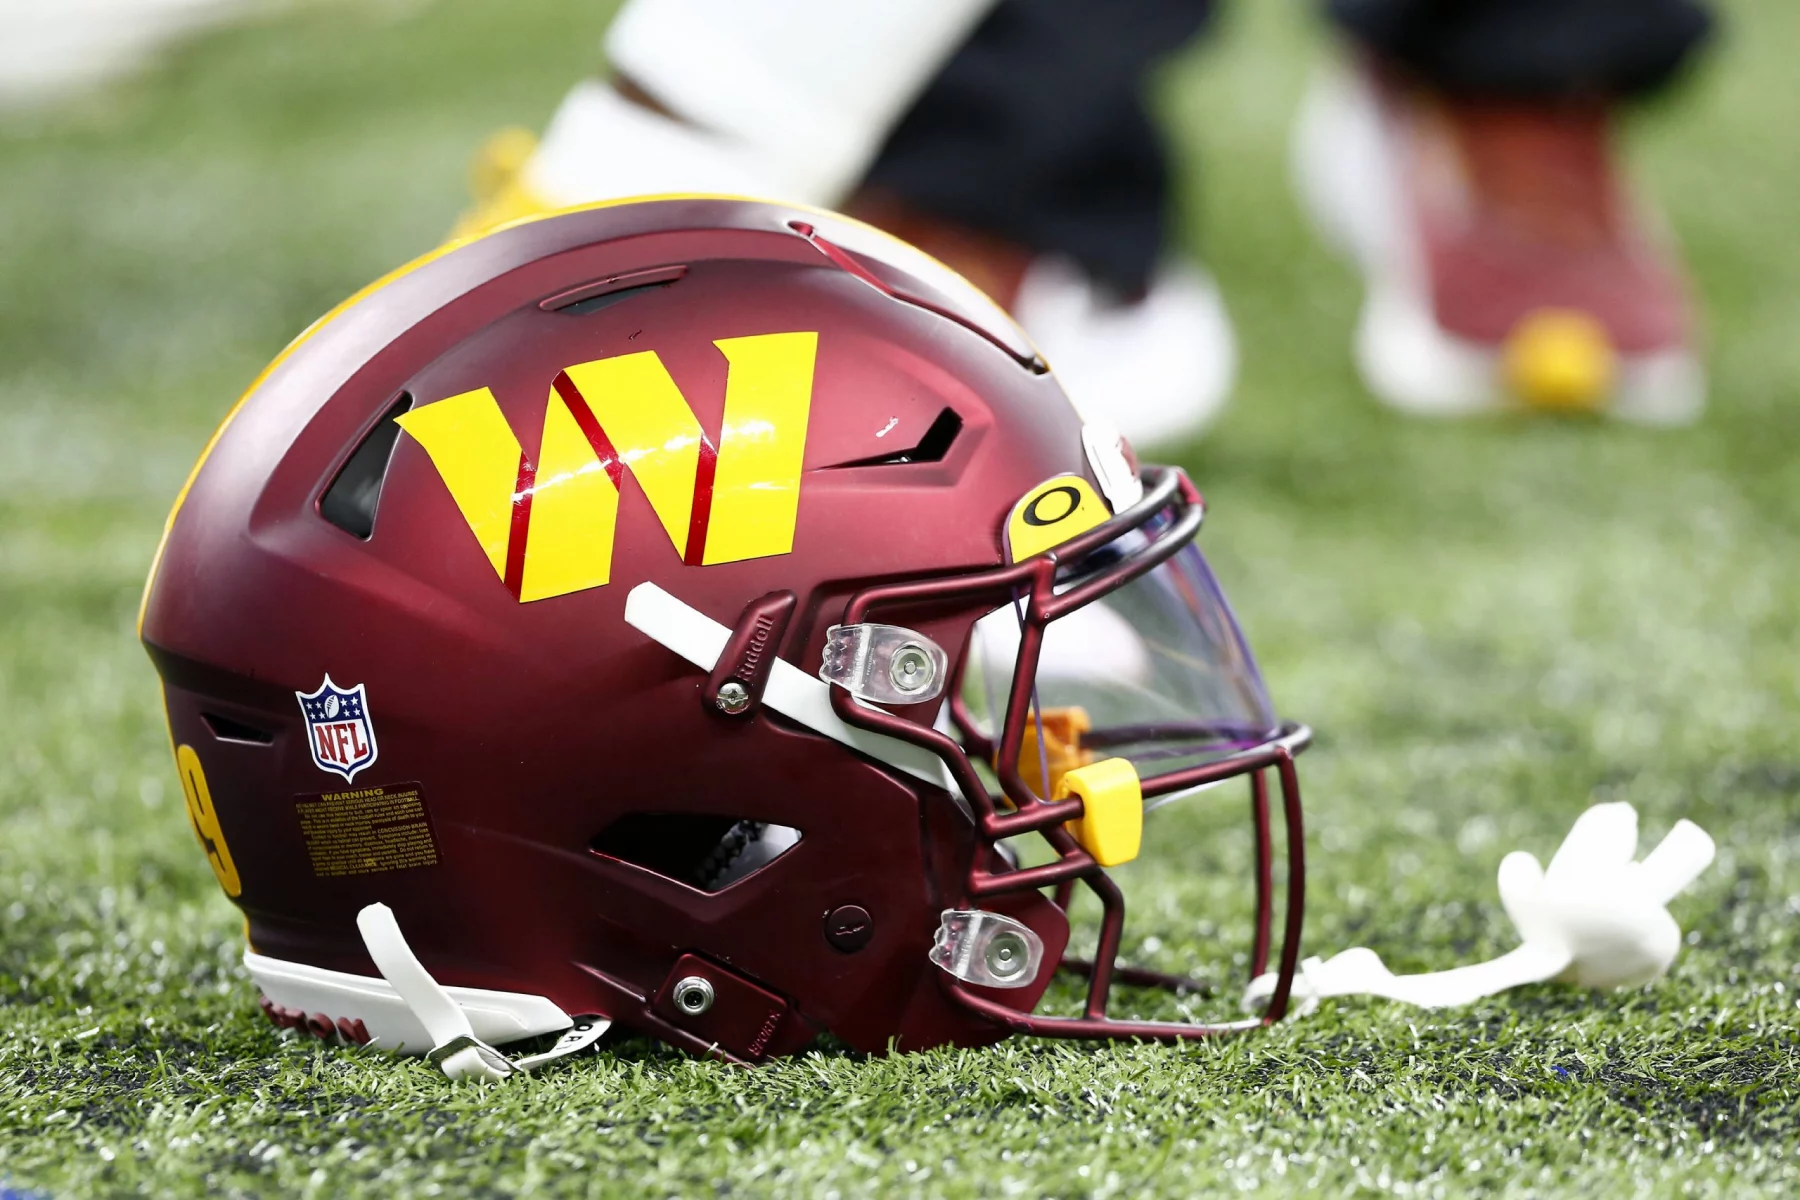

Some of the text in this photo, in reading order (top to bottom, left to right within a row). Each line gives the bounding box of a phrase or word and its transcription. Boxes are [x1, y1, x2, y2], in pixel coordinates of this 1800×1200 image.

[314, 722, 368, 766] NFL
[321, 788, 384, 801] WARNING
[177, 743, 242, 898] 9
